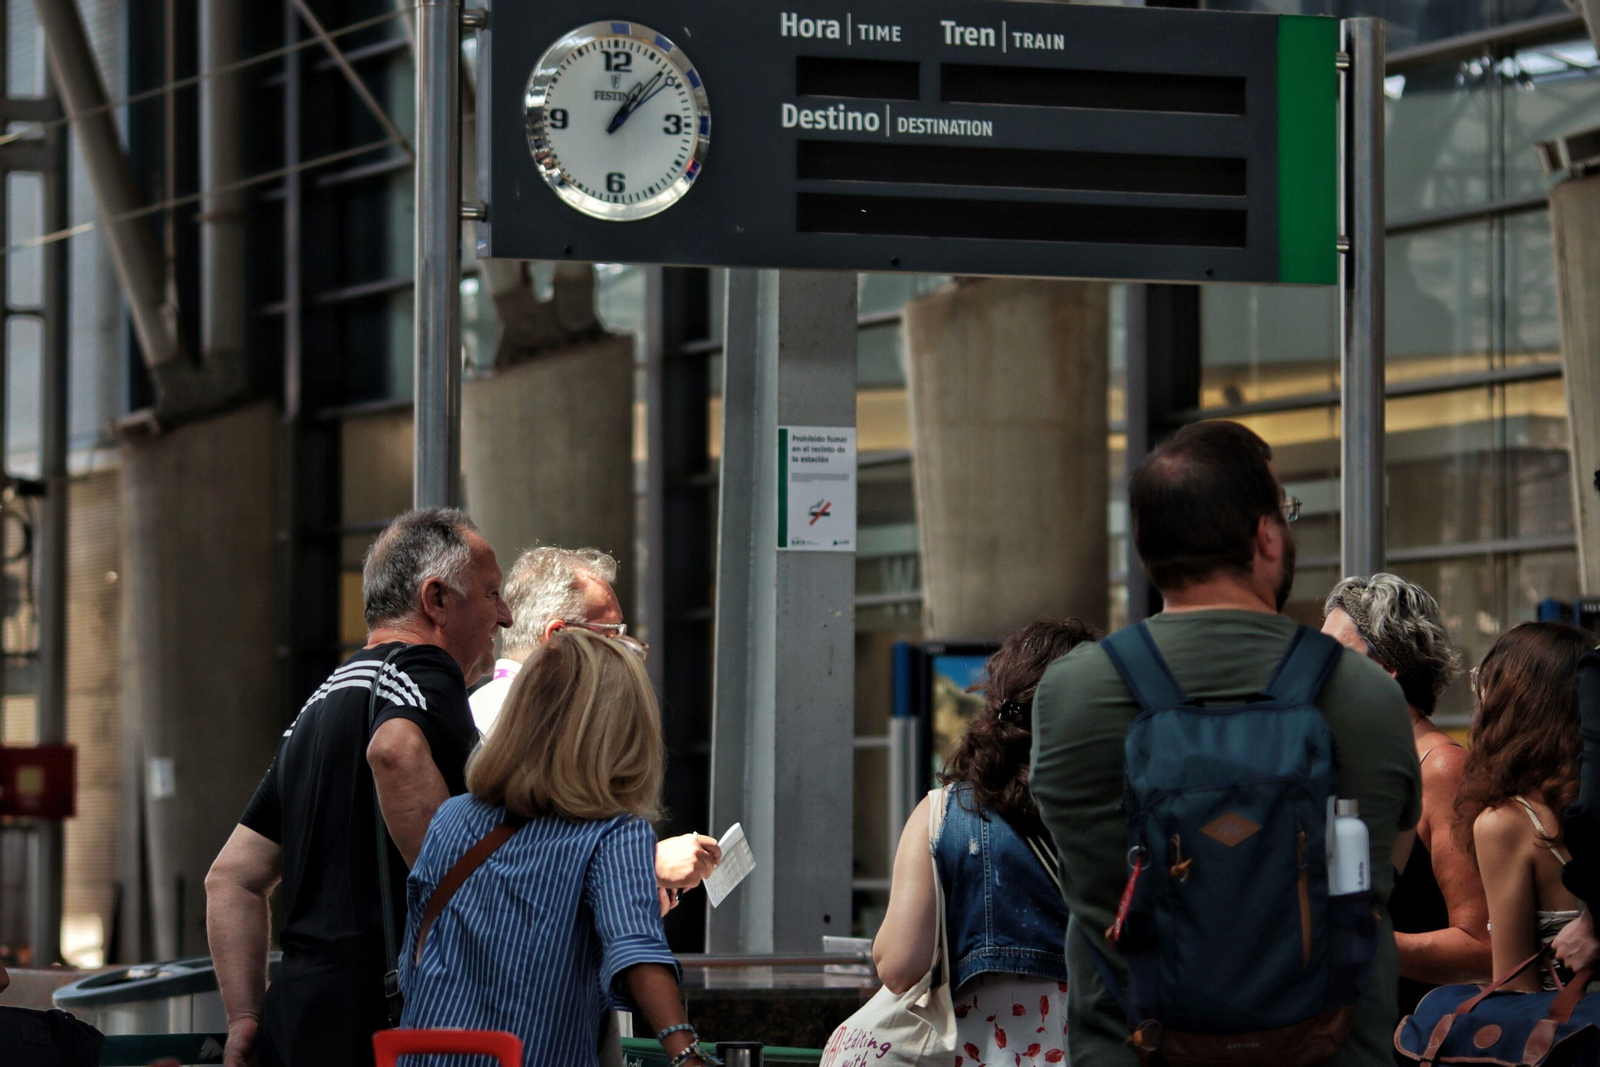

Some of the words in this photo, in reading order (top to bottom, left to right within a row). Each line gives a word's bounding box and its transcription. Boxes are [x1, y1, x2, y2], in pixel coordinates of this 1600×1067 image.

[780, 12, 840, 40] Hora
[857, 24, 902, 42] TIME
[940, 20, 996, 47] Tren
[1012, 32, 1065, 50] TRAIN
[600, 50, 632, 73] 12
[550, 108, 569, 130] 9
[663, 114, 682, 135] 3
[781, 103, 880, 132] Destino
[898, 117, 993, 137] DESTINATION
[605, 172, 625, 193] 6
[792, 435, 826, 443] Prohibido
[827, 435, 848, 443] fumar
[803, 445, 810, 453] el
[792, 455, 799, 463] la
[801, 455, 830, 463] estación
